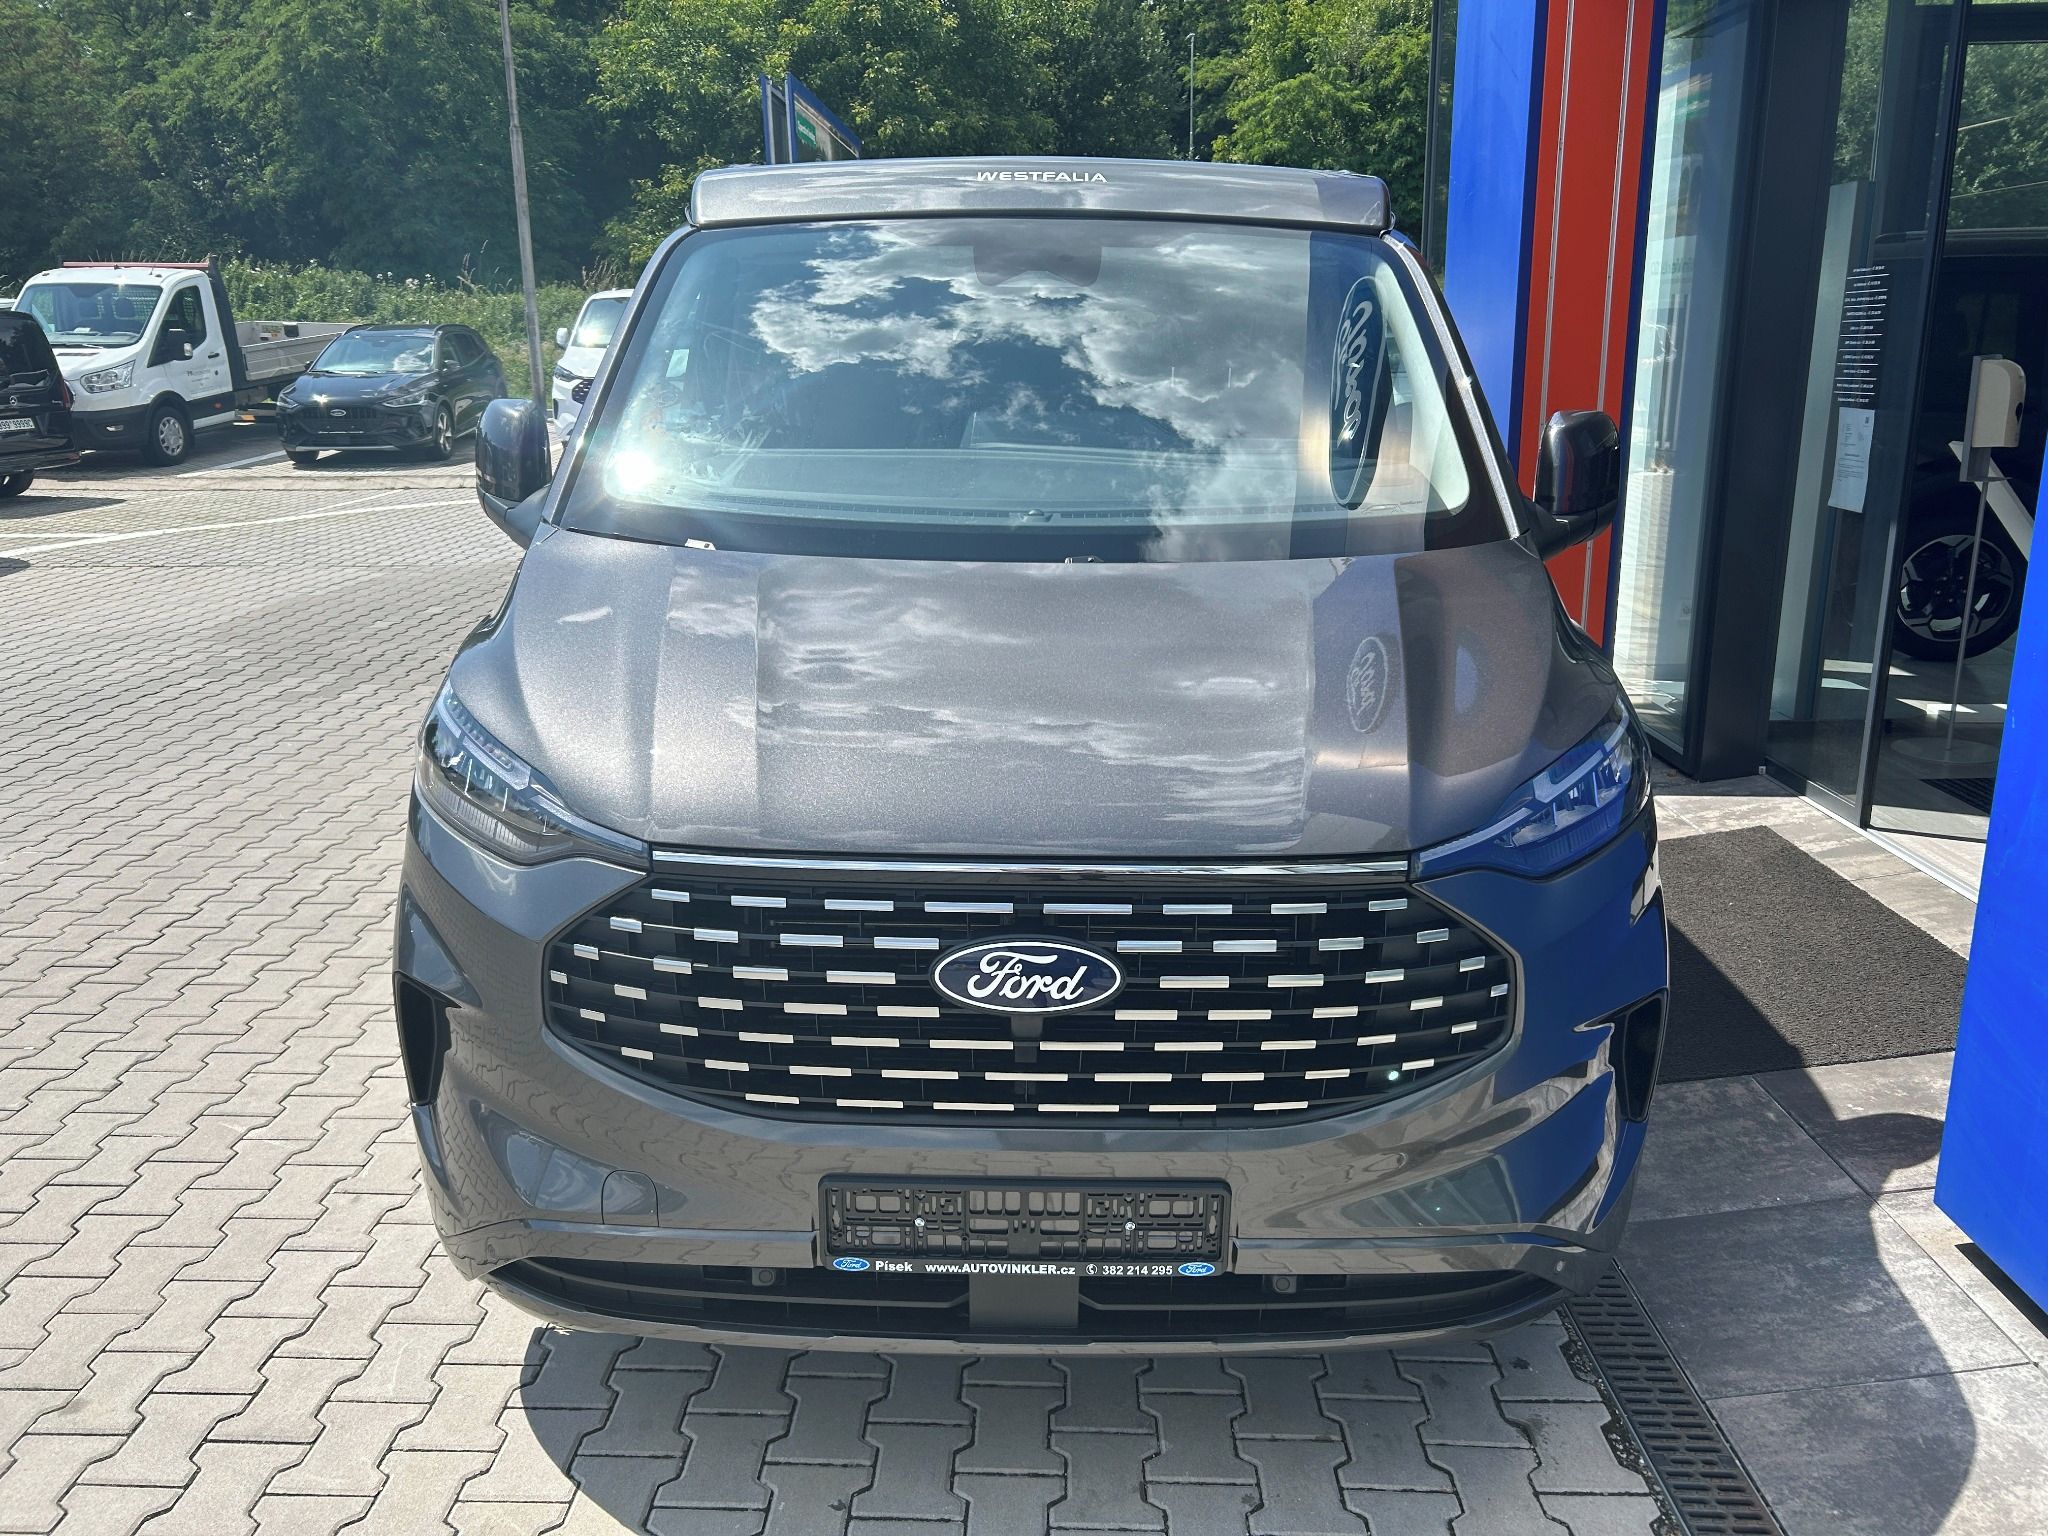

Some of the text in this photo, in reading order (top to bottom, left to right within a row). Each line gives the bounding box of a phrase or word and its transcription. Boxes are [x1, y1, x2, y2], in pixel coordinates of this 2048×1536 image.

[977, 171, 1108, 183] WESTFALIA
[967, 951, 1088, 1000] Ford
[875, 1260, 913, 1272] Písek
[925, 1263, 1076, 1275] www.AUTOVINKLER.cz
[1102, 1265, 1124, 1275] 382
[1126, 1265, 1149, 1276] 214
[1151, 1265, 1173, 1276] 295
